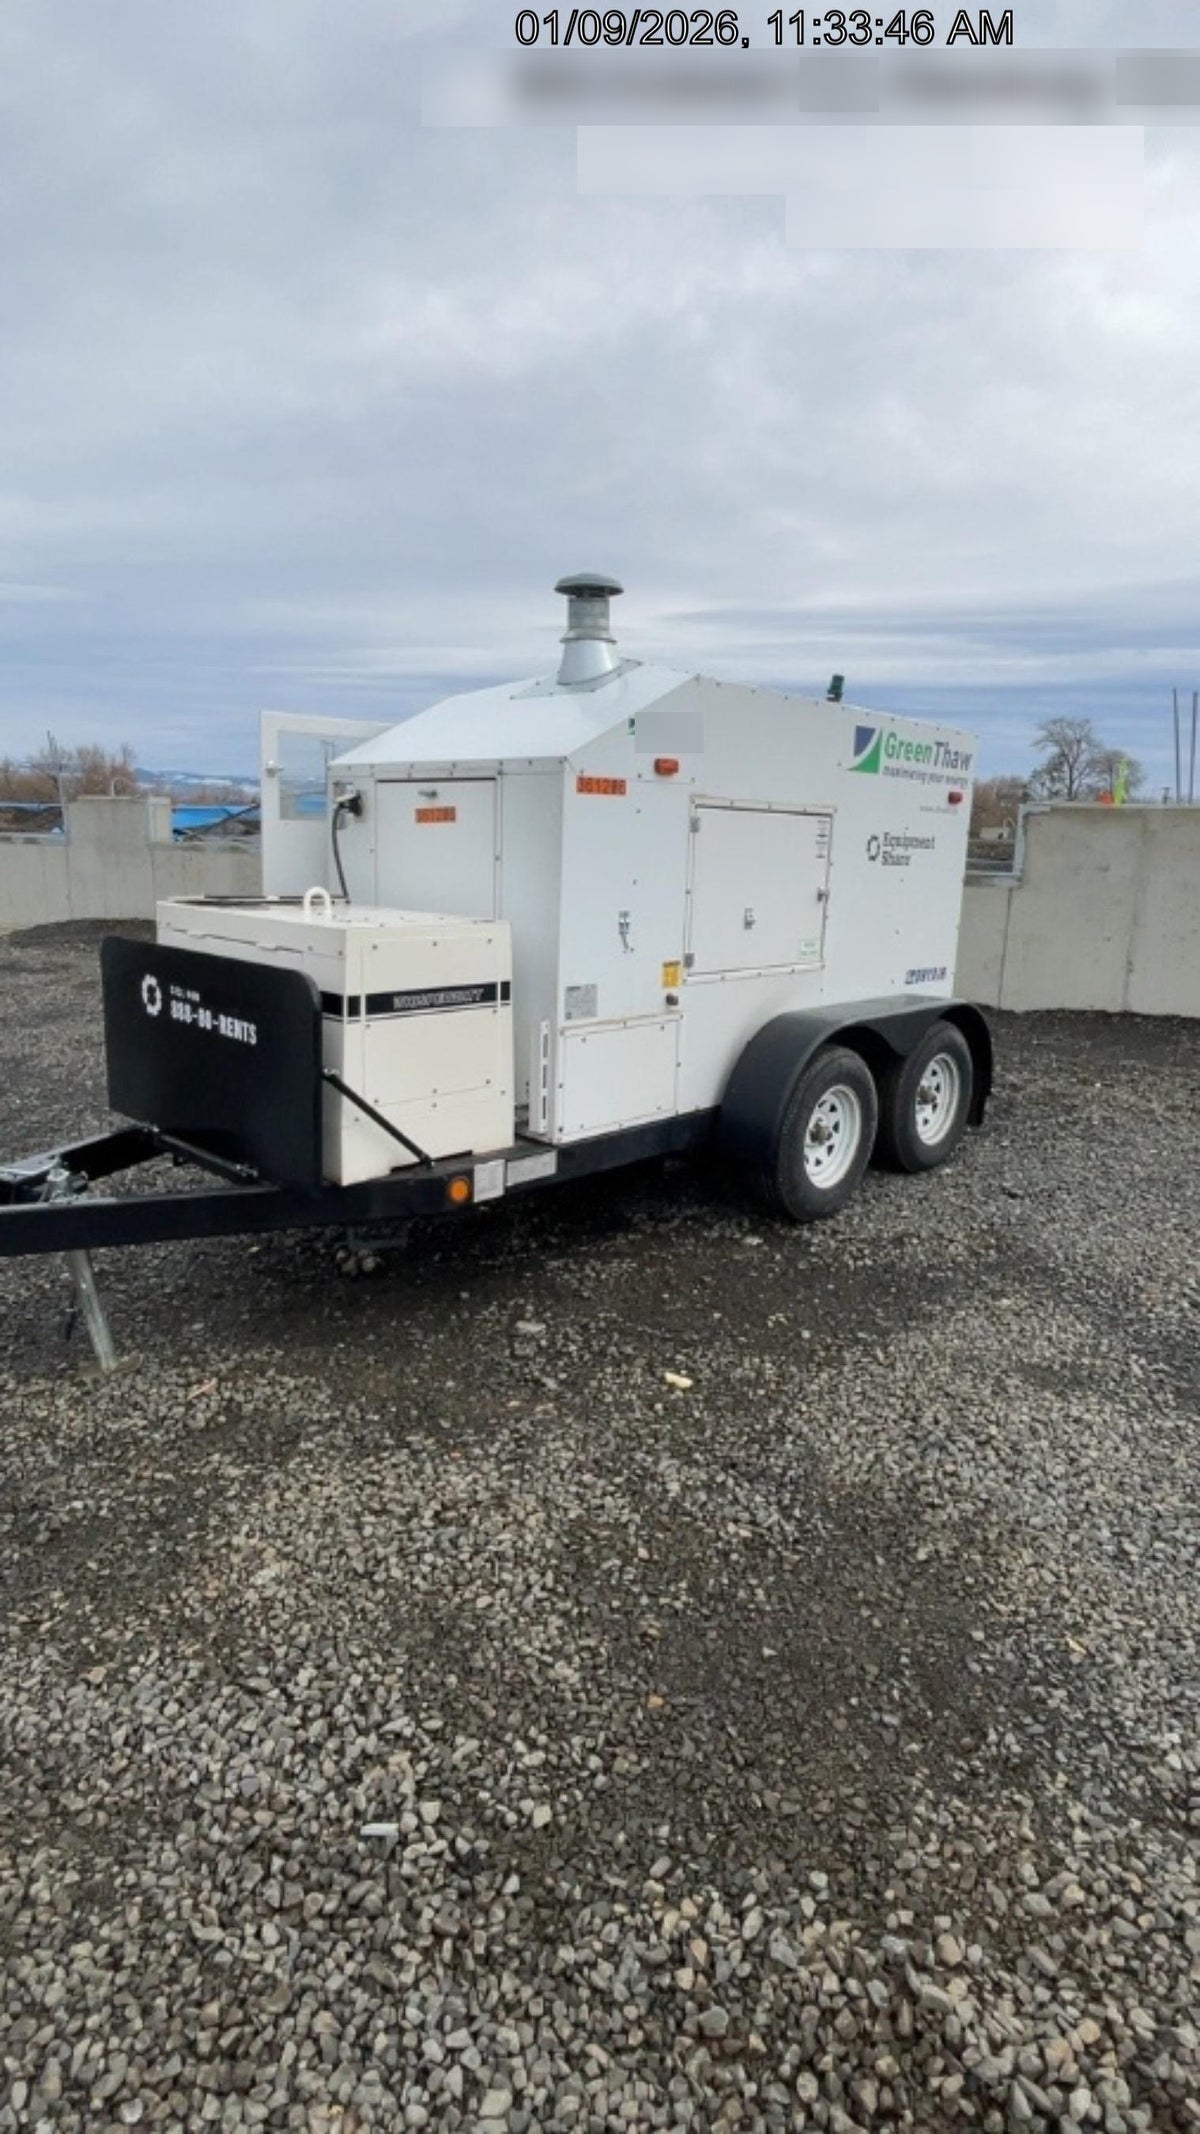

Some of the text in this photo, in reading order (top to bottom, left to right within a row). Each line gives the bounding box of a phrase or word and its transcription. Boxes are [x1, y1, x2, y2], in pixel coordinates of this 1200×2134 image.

[884, 731, 973, 771] GreenThaw
[883, 832, 936, 852] Equipment
[882, 850, 911, 866] Share
